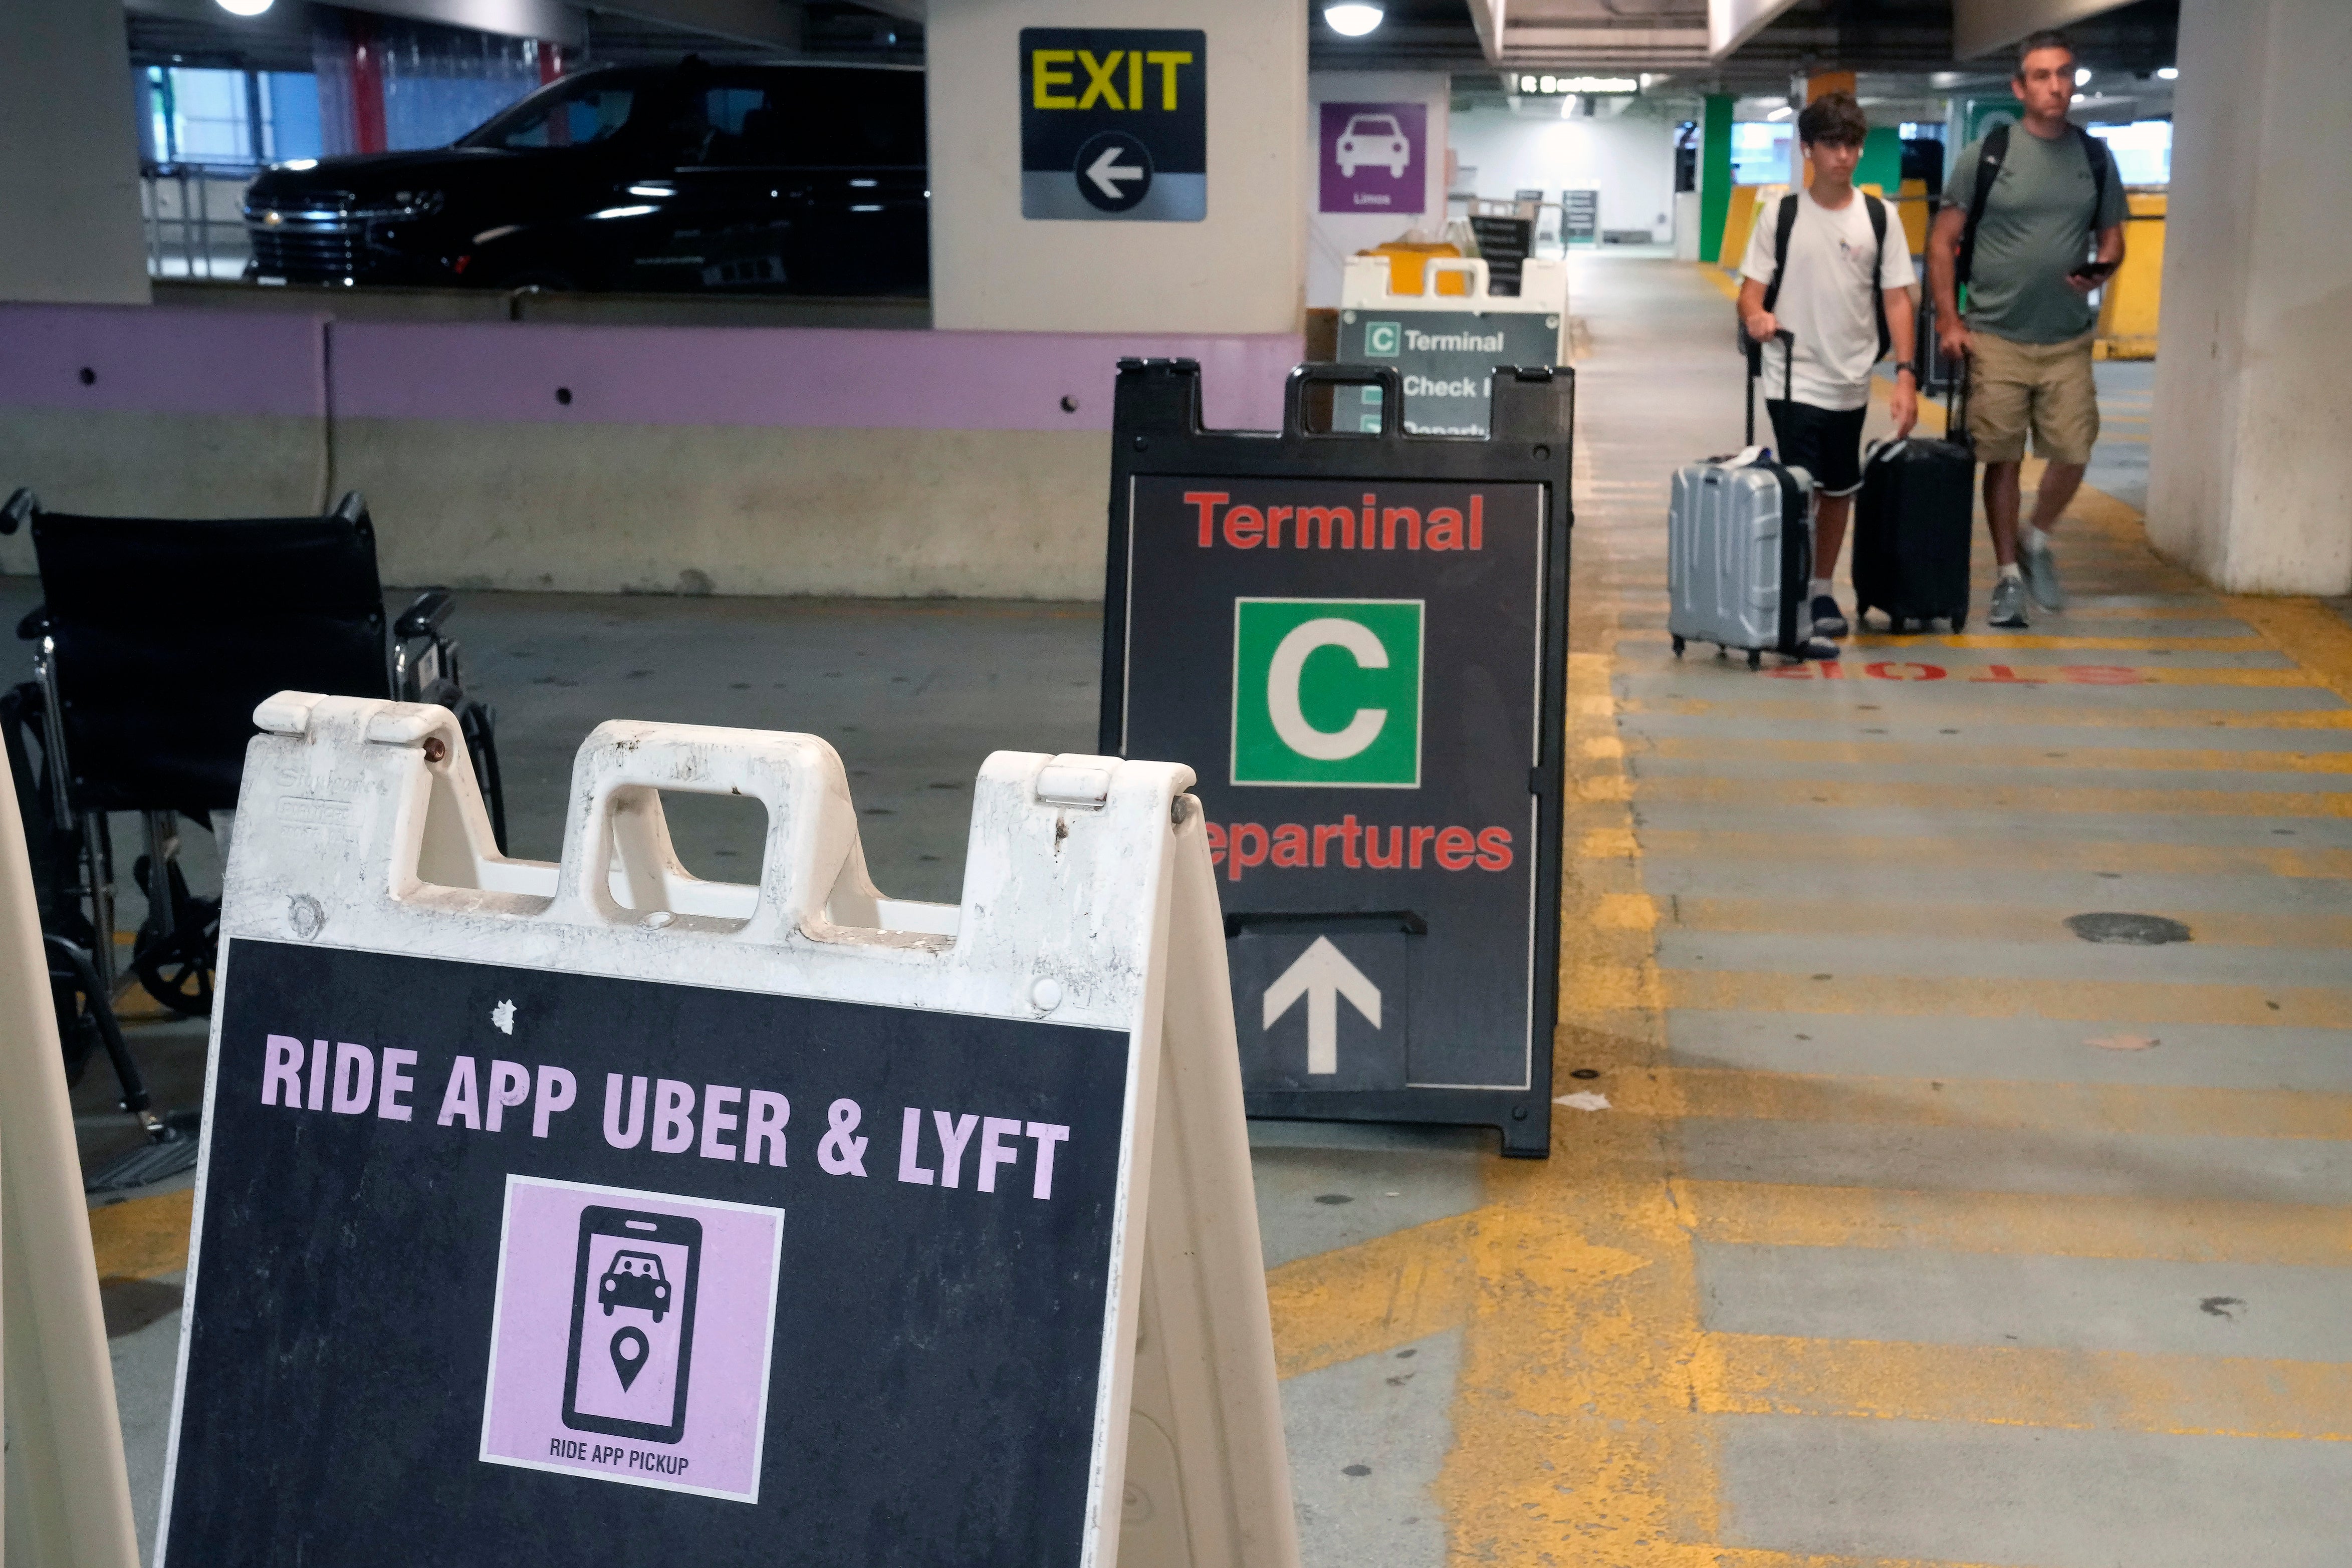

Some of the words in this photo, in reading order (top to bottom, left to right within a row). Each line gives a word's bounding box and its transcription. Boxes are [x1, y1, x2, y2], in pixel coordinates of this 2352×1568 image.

[1033, 50, 1193, 111] EXIT
[1373, 327, 1393, 351] C
[1405, 330, 1504, 352] Terminal
[1402, 375, 1476, 397] Check
[1184, 491, 1484, 552] Terminal
[1267, 617, 1389, 761] C
[1204, 815, 1513, 881] epartures
[261, 1034, 418, 1123] RIDE
[436, 1055, 577, 1139] APP
[603, 1073, 791, 1168] UBER
[817, 1098, 869, 1177] &
[898, 1106, 1070, 1201] LYFT
[550, 1438, 587, 1460] RIDE
[591, 1445, 624, 1465] APP
[629, 1450, 688, 1475] PICKUP
